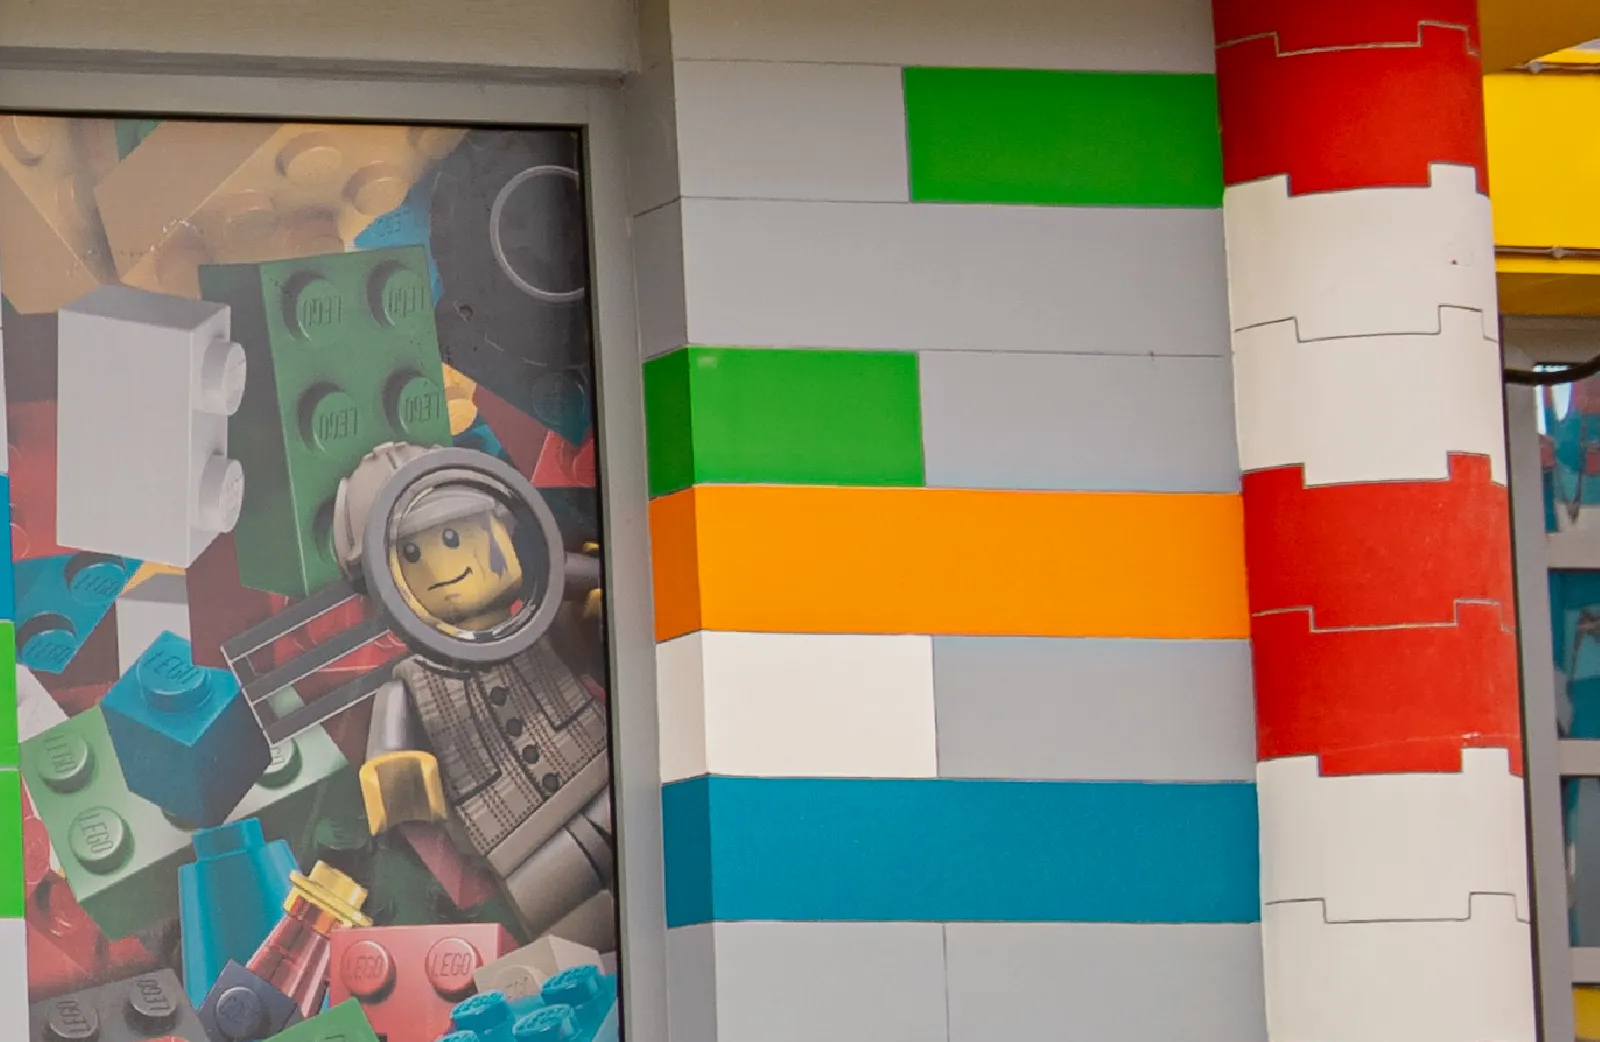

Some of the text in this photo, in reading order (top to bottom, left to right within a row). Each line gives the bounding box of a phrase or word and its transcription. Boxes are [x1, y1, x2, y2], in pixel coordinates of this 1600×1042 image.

[302, 295, 341, 327] LEGO
[318, 407, 358, 441] LEGO
[405, 393, 439, 423] LEGO
[78, 810, 114, 854] LEGO
[431, 951, 473, 978] LEGO
[137, 979, 170, 1011] LEGO
[56, 1000, 91, 1033] LEGO
